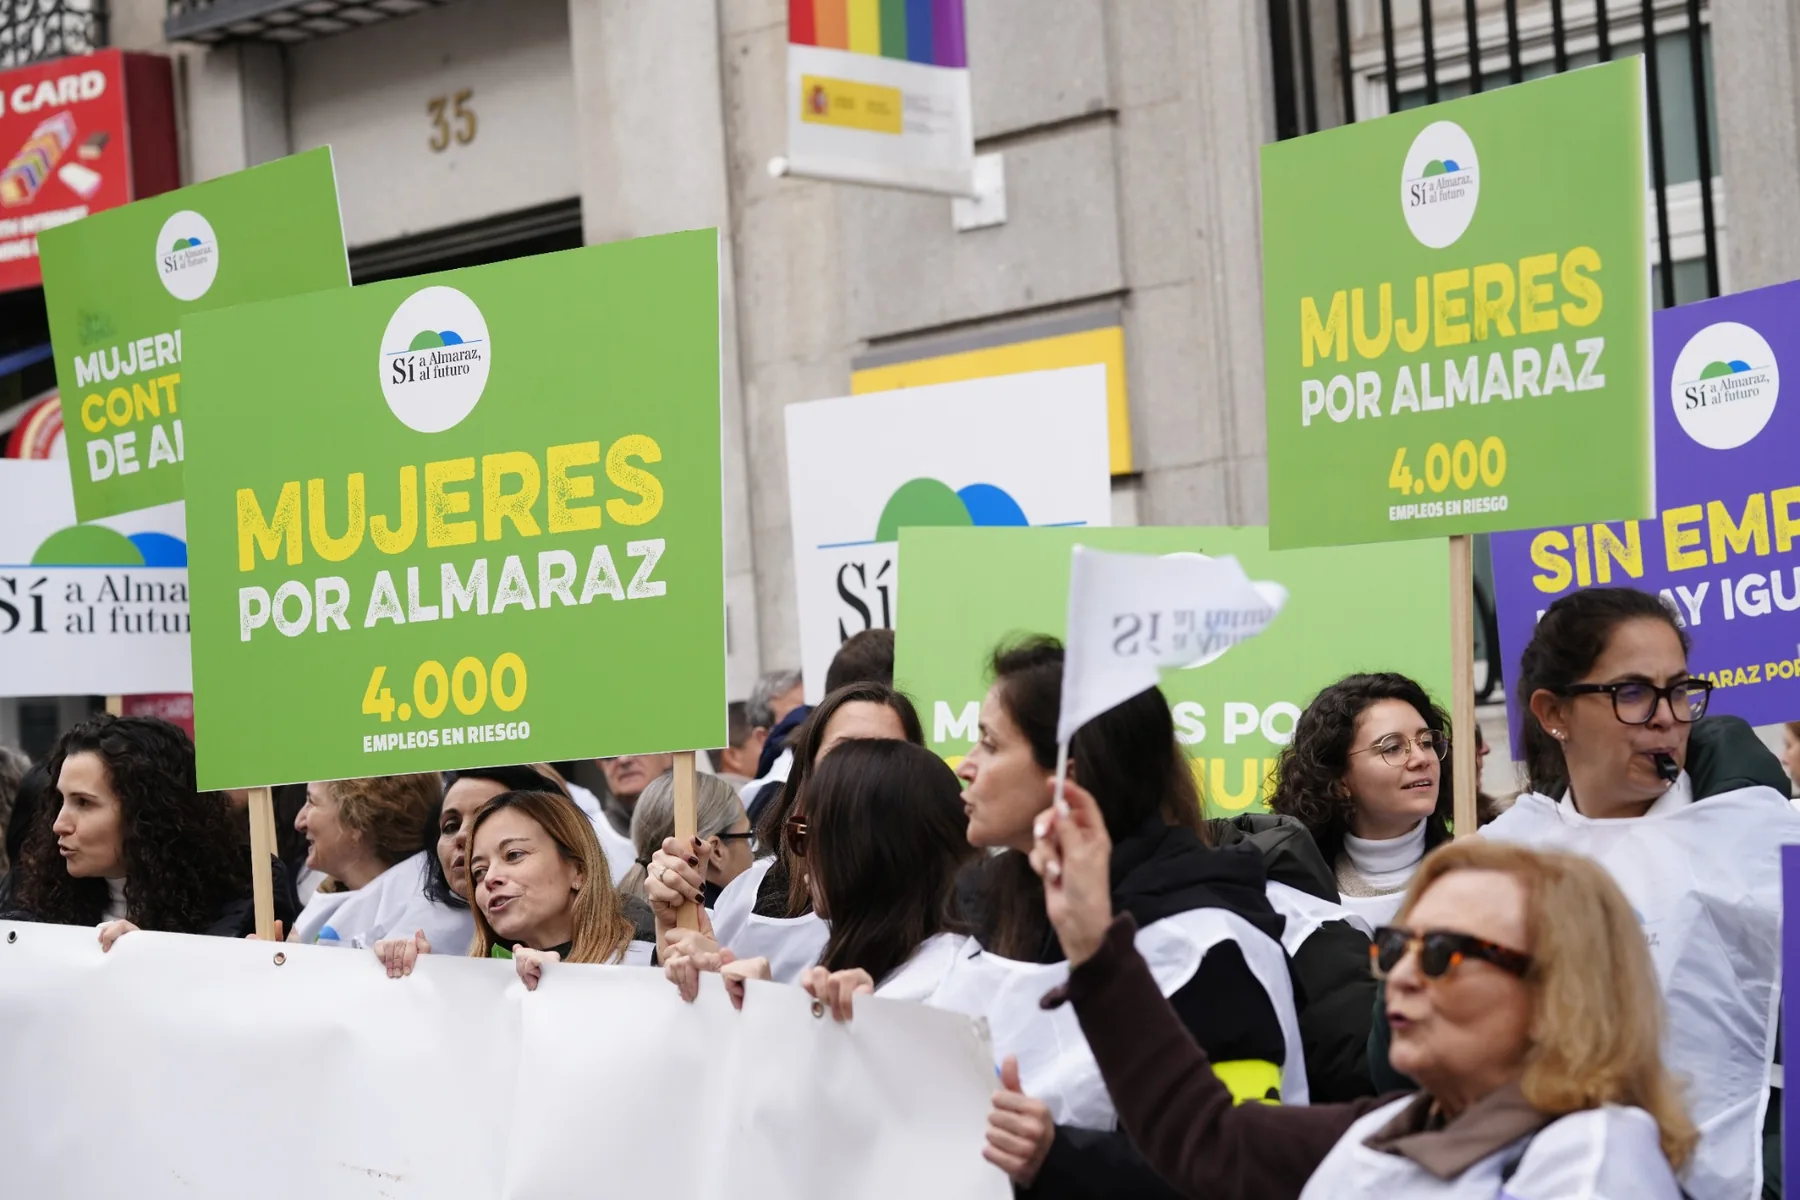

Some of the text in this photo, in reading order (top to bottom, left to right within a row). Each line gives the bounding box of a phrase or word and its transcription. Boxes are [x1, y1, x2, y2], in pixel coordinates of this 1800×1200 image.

[10, 70, 107, 114] CARD
[427, 87, 478, 152] 35
[1411, 174, 1473, 207] Sí a Almaraz,
[1429, 188, 1465, 203] al futuro
[164, 254, 178, 273] Sí
[1301, 246, 1603, 368] MUJERES
[392, 348, 481, 385] Sí a Almaraz,
[419, 364, 470, 381] al futuro
[1302, 336, 1606, 427] POR ALMARAZ
[1685, 373, 1770, 410] Sí a Almaraz,
[1711, 387, 1760, 405] al futuro
[86, 431, 140, 482] DE
[1388, 435, 1507, 495] 4.000
[235, 434, 664, 572] MUJERES
[1389, 495, 1509, 521] EMPLEOS EN RIESGO
[1530, 486, 1800, 593] SIN EMP
[0, 576, 49, 635] Sí
[65, 582, 85, 603] a
[238, 538, 667, 642] POR ALMARAZ
[837, 558, 893, 644] Sí
[65, 605, 96, 634] al
[362, 652, 527, 722] 4.000
[363, 721, 530, 753] EMPLEOS EN RIESGO
